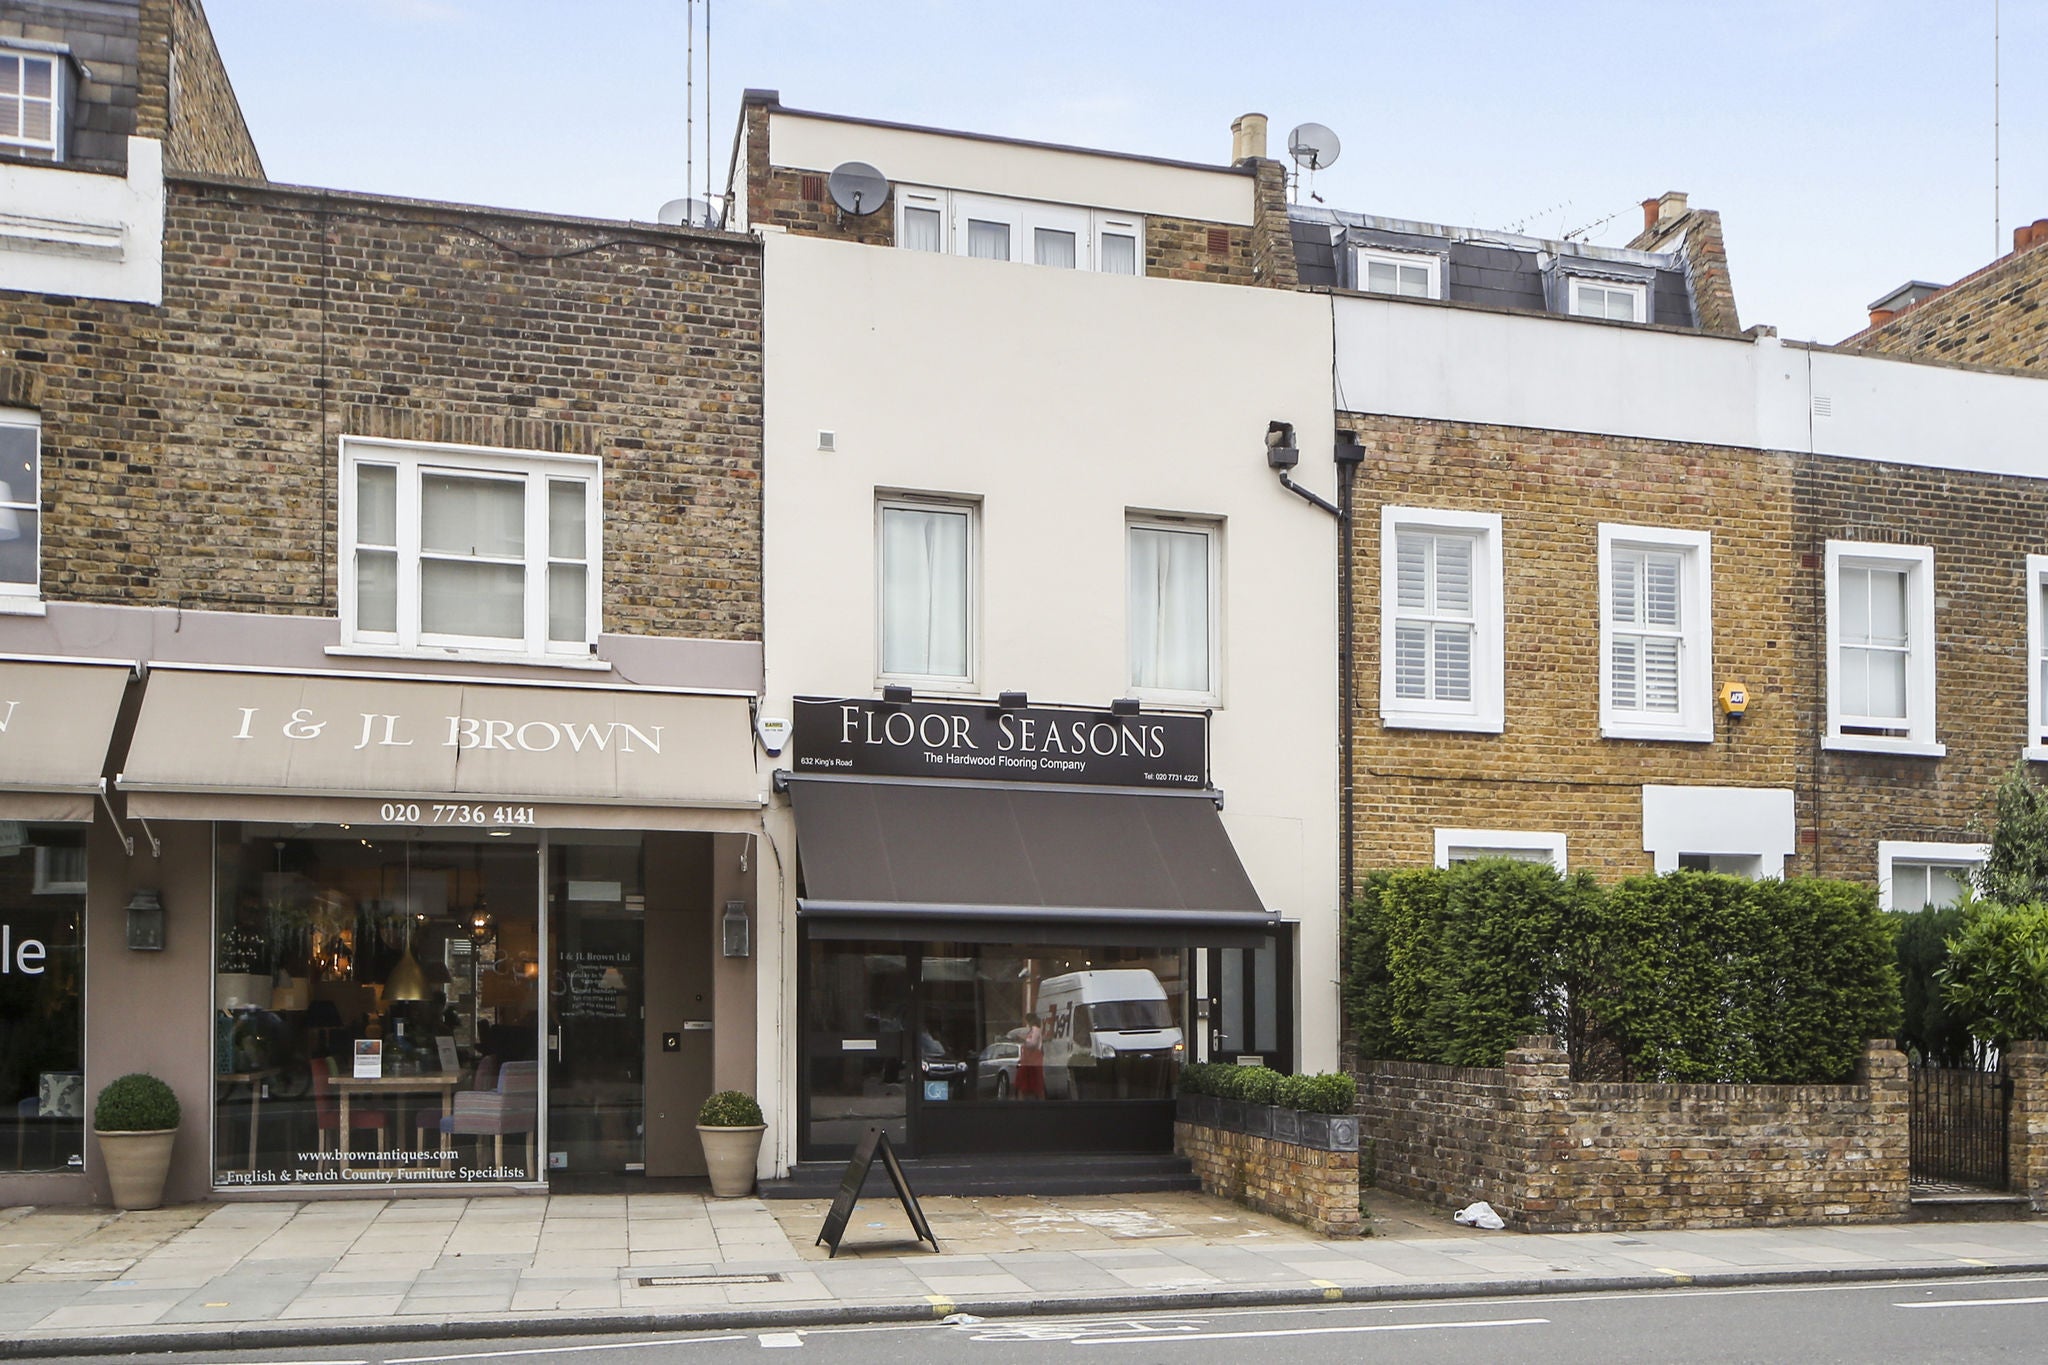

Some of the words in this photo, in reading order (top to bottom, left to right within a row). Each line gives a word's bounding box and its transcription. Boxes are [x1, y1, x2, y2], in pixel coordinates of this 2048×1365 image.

[232, 706, 259, 739] I
[282, 708, 328, 740] &
[354, 713, 414, 750] JL
[442, 714, 664, 754] BROWN
[840, 705, 979, 750] FLOOR
[997, 714, 1165, 759] SEASONS
[800, 757, 813, 765] 632
[814, 758, 834, 767] King's
[835, 758, 853, 767] Road
[924, 752, 943, 764] The
[946, 753, 995, 766] Hardwood
[998, 756, 1037, 770] Flooring
[1039, 758, 1086, 771] Company
[1155, 773, 1167, 781] 020
[1168, 774, 1182, 782] 7731
[380, 804, 421, 825] 020
[432, 805, 486, 826] 7736
[493, 806, 536, 826] 4141
[587, 952, 614, 960] Brown
[298, 1148, 459, 1163] www.brownantiques.com
[227, 1170, 276, 1184] English
[280, 1170, 291, 1181] &
[295, 1168, 338, 1181] French
[342, 1168, 393, 1183] Country
[397, 1168, 456, 1180] Furniture
[459, 1166, 525, 1181] Specialists
